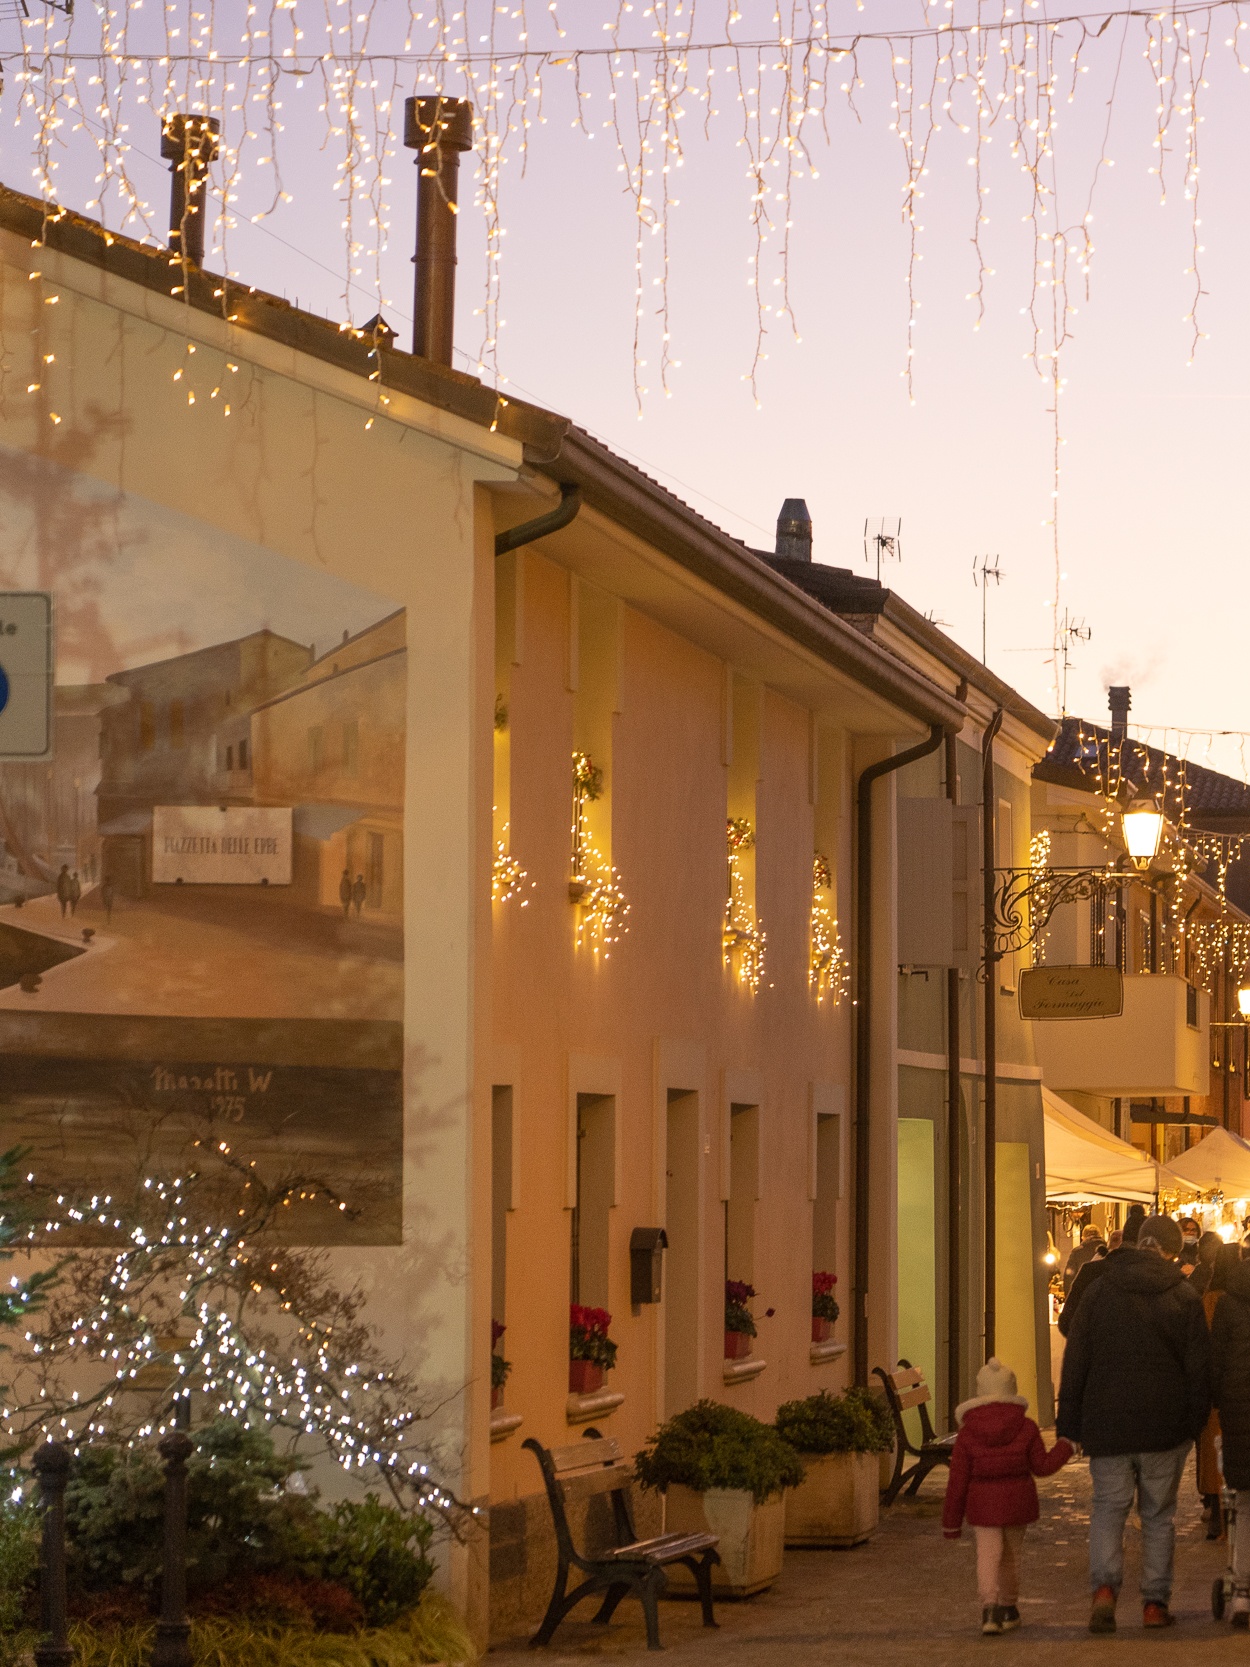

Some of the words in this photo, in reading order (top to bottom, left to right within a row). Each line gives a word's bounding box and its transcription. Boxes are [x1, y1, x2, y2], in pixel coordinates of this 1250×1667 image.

[164, 836, 217, 854] PIAZZETTA
[221, 837, 250, 854] DELLE
[254, 837, 279, 855] ERBE
[1046, 975, 1081, 986] Casa
[1033, 998, 1106, 1013] Formaggio
[247, 1067, 273, 1093] W
